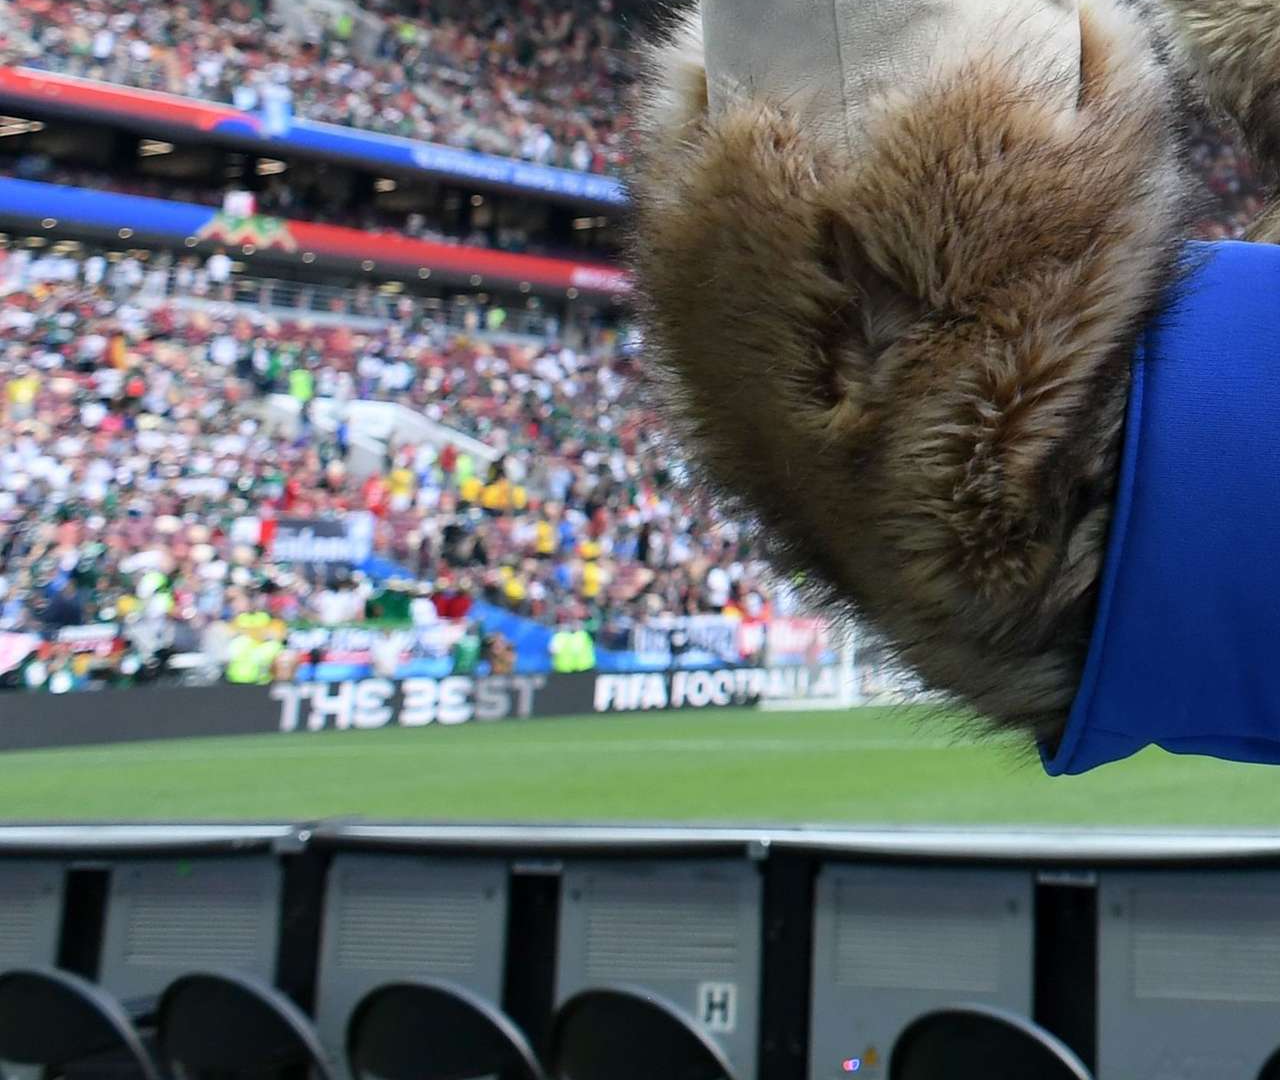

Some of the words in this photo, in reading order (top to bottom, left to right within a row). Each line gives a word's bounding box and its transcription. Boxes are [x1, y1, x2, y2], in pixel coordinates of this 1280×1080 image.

[270, 679, 394, 732] THE
[398, 674, 548, 727] BEST
[593, 672, 668, 712] FIFA
[704, 991, 730, 1024] H
